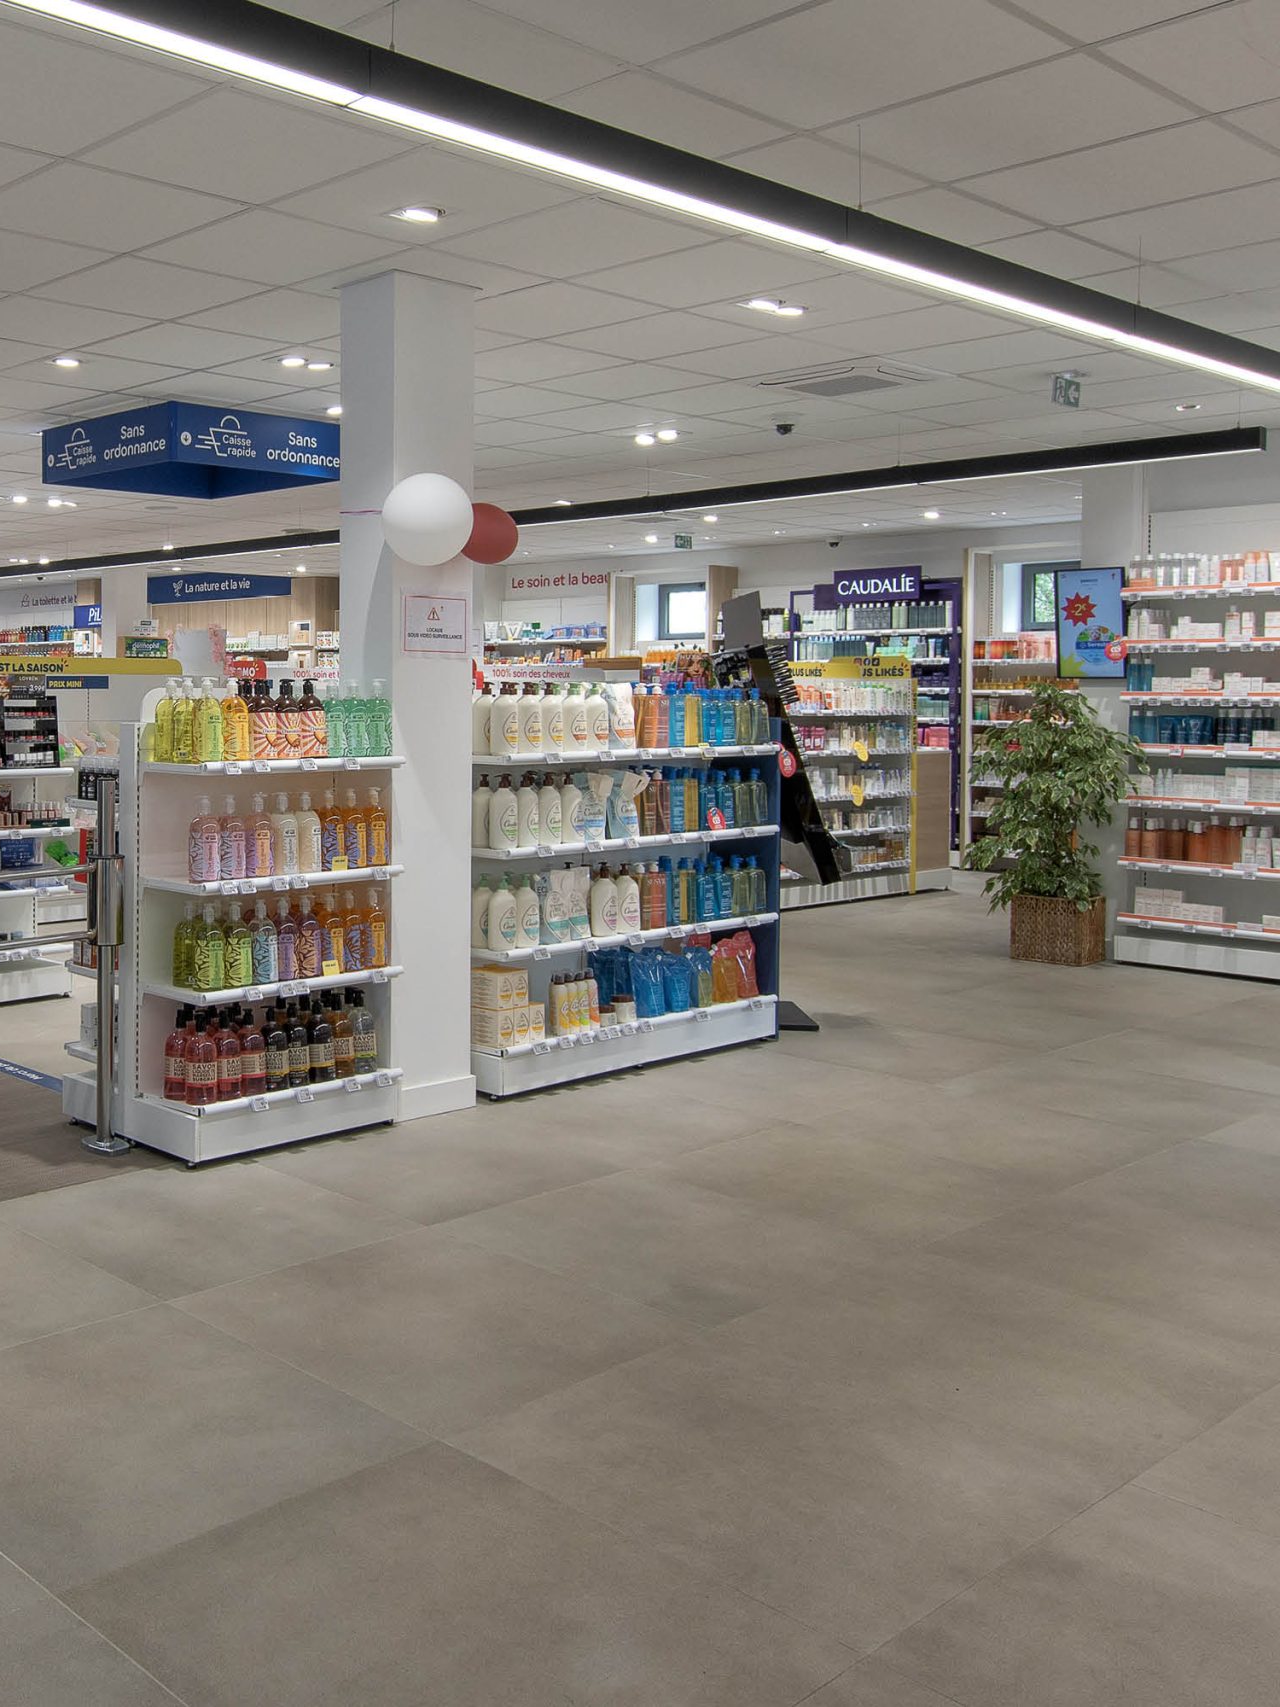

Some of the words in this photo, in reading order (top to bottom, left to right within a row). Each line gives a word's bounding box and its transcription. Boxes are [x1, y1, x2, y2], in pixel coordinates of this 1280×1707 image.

[120, 424, 145, 440] Sans
[222, 434, 252, 447] Caisse
[288, 432, 317, 448] Sans
[72, 443, 93, 456] Caisse
[103, 439, 166, 461] ordonnance
[227, 446, 257, 459] rapide
[75, 453, 97, 467] rapide
[266, 449, 340, 468] ordonnance
[185, 583, 194, 593] La
[195, 582, 220, 592] nature
[221, 581, 228, 591] et
[230, 580, 237, 590] la
[238, 579, 251, 589] vie
[511, 576, 525, 590] Le
[527, 574, 551, 588] soin
[553, 574, 566, 587] et
[568, 573, 579, 585] la
[838, 573, 915, 595] CAUDALÍE
[12, 664, 25, 673] LA
[27, 664, 64, 673] SAISON
[293, 670, 311, 679] 100%
[313, 670, 327, 678] soin
[328, 670, 336, 678] et
[493, 669, 511, 678] 100%
[513, 670, 527, 678] soin
[529, 670, 540, 678] des
[543, 670, 570, 678] cheveux
[805, 667, 822, 677] LIKÉS
[875, 666, 904, 677] LIKÉS
[66, 680, 82, 688] MINI
